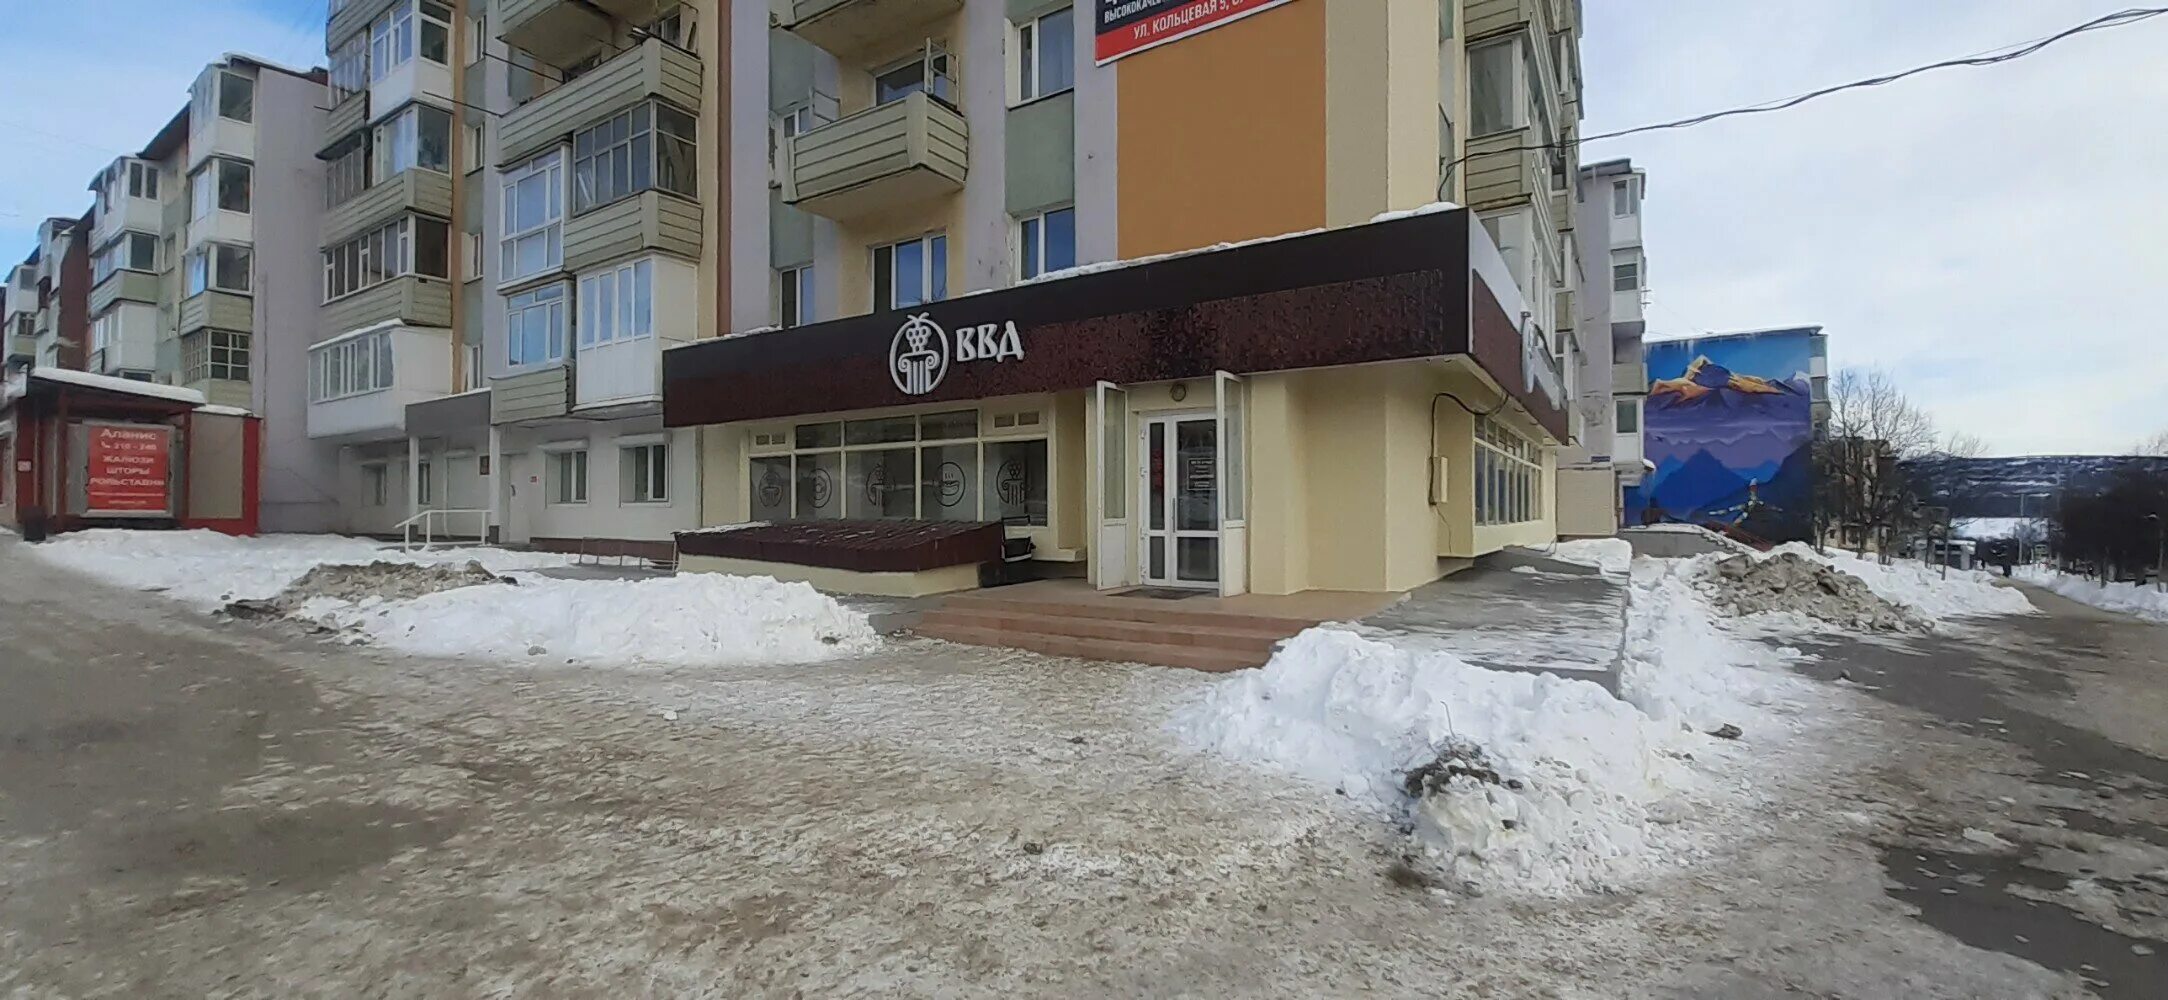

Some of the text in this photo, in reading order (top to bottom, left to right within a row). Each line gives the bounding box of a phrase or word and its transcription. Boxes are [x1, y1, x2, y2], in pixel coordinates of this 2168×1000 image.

[1133, 24, 1150, 40] УЛ.
[1152, 0, 1217, 34] КОЛЬЦЕВАЯ
[956, 320, 1025, 363] ВВД
[106, 467, 150, 475] ШТОРЫ
